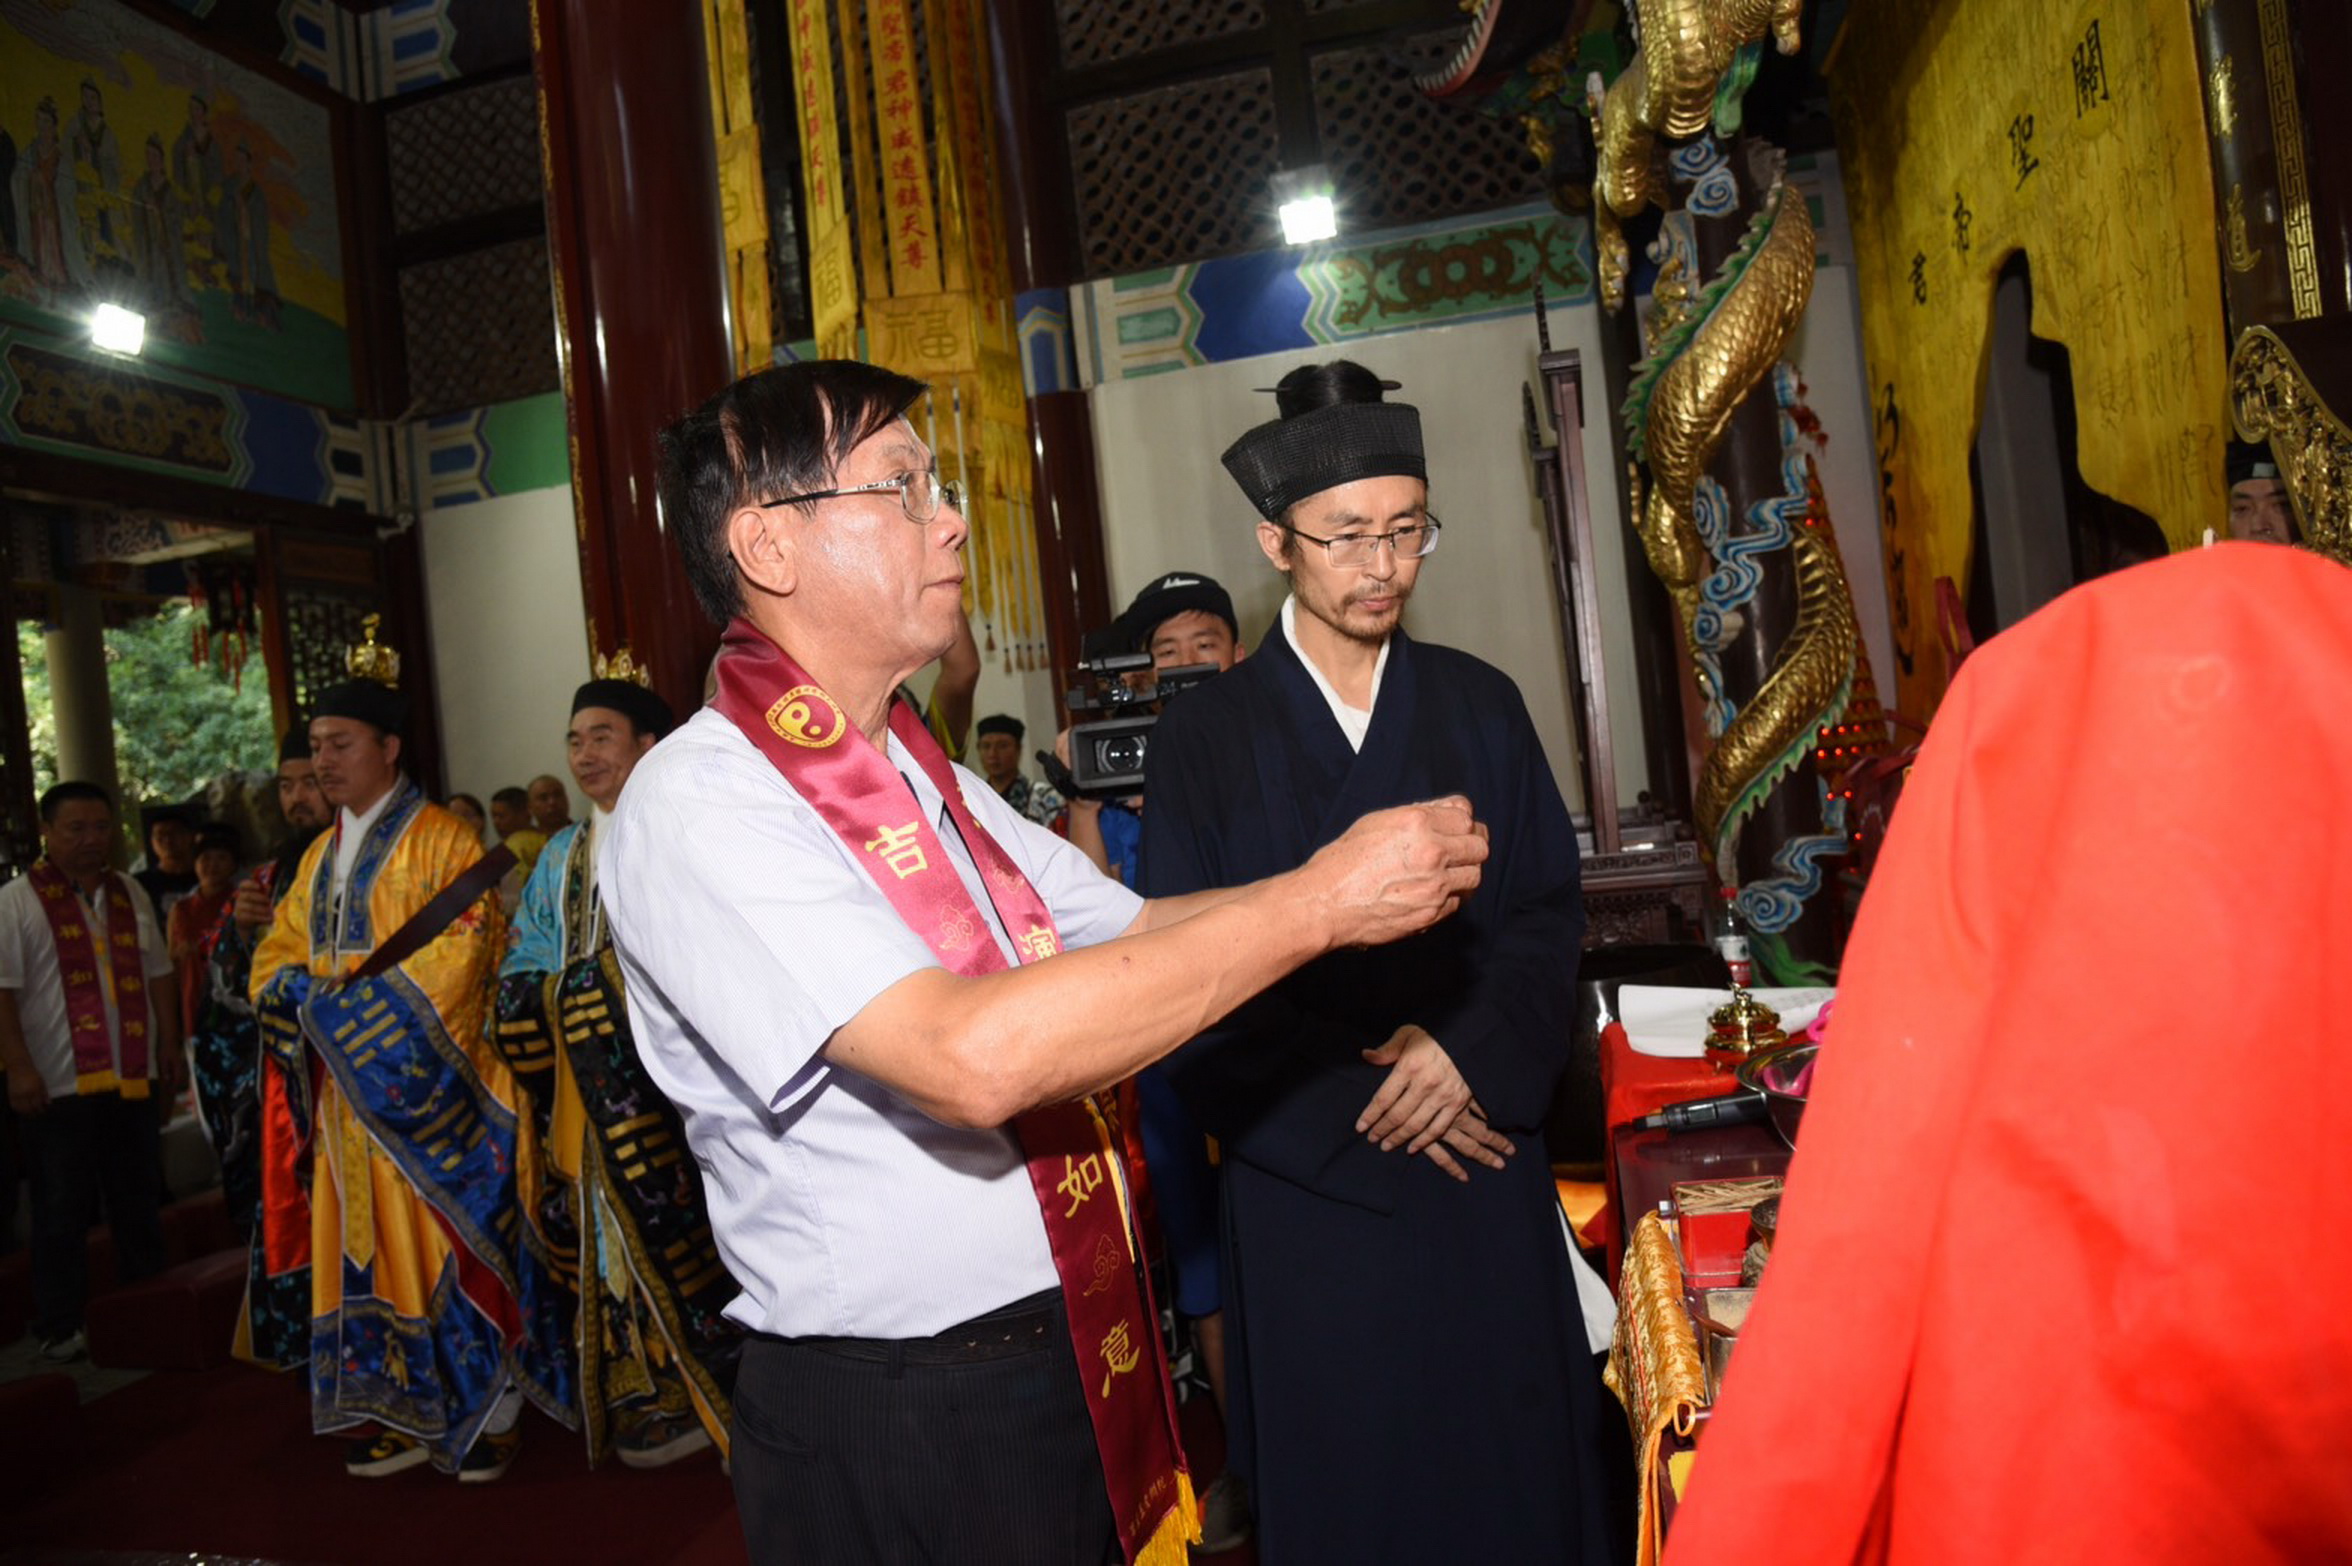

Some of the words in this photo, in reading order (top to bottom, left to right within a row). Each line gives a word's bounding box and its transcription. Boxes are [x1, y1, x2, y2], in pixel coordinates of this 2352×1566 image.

[879, 0, 928, 270] 聖帝君神威遠鎮天尊
[864, 820, 929, 880] 吉
